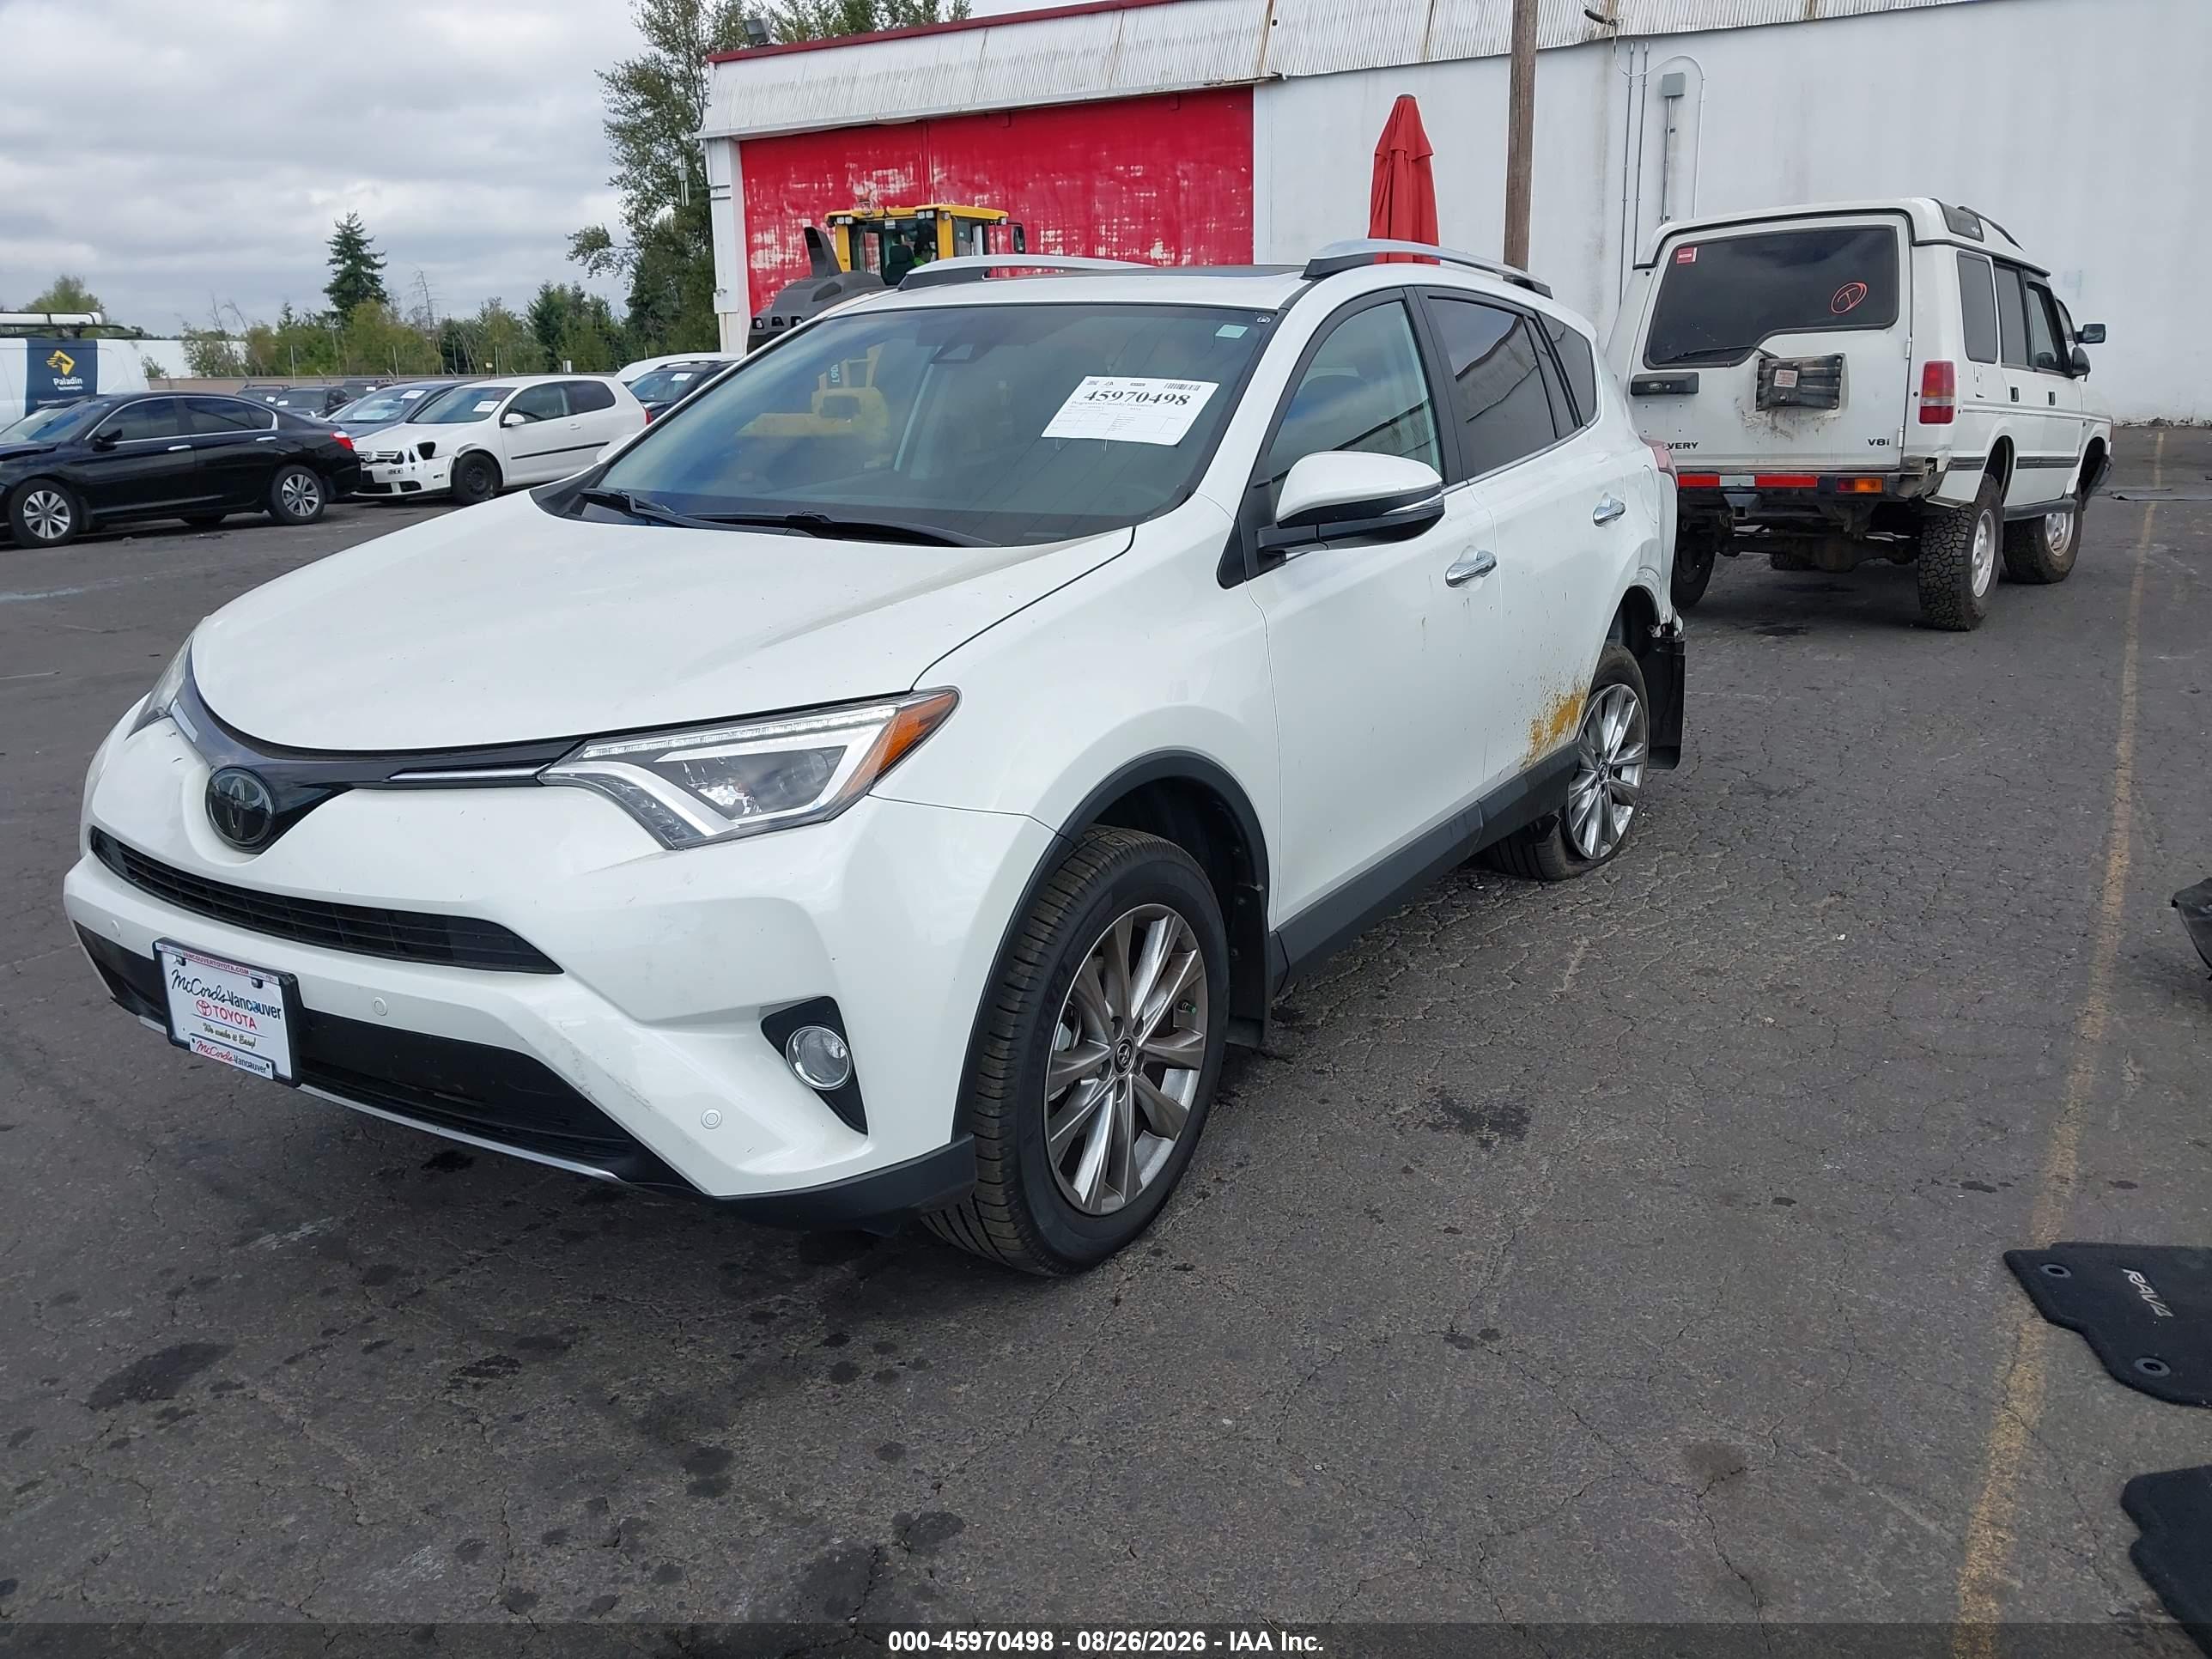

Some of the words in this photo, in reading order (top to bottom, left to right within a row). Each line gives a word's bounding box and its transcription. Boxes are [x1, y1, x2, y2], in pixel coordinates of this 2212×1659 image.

[52, 377, 82, 386] Paladin
[1084, 389, 1191, 406] 45970498
[1868, 438, 1890, 447] V8i
[213, 1005, 258, 1030] TOYOTA
[2122, 1268, 2174, 1317] RAV4
